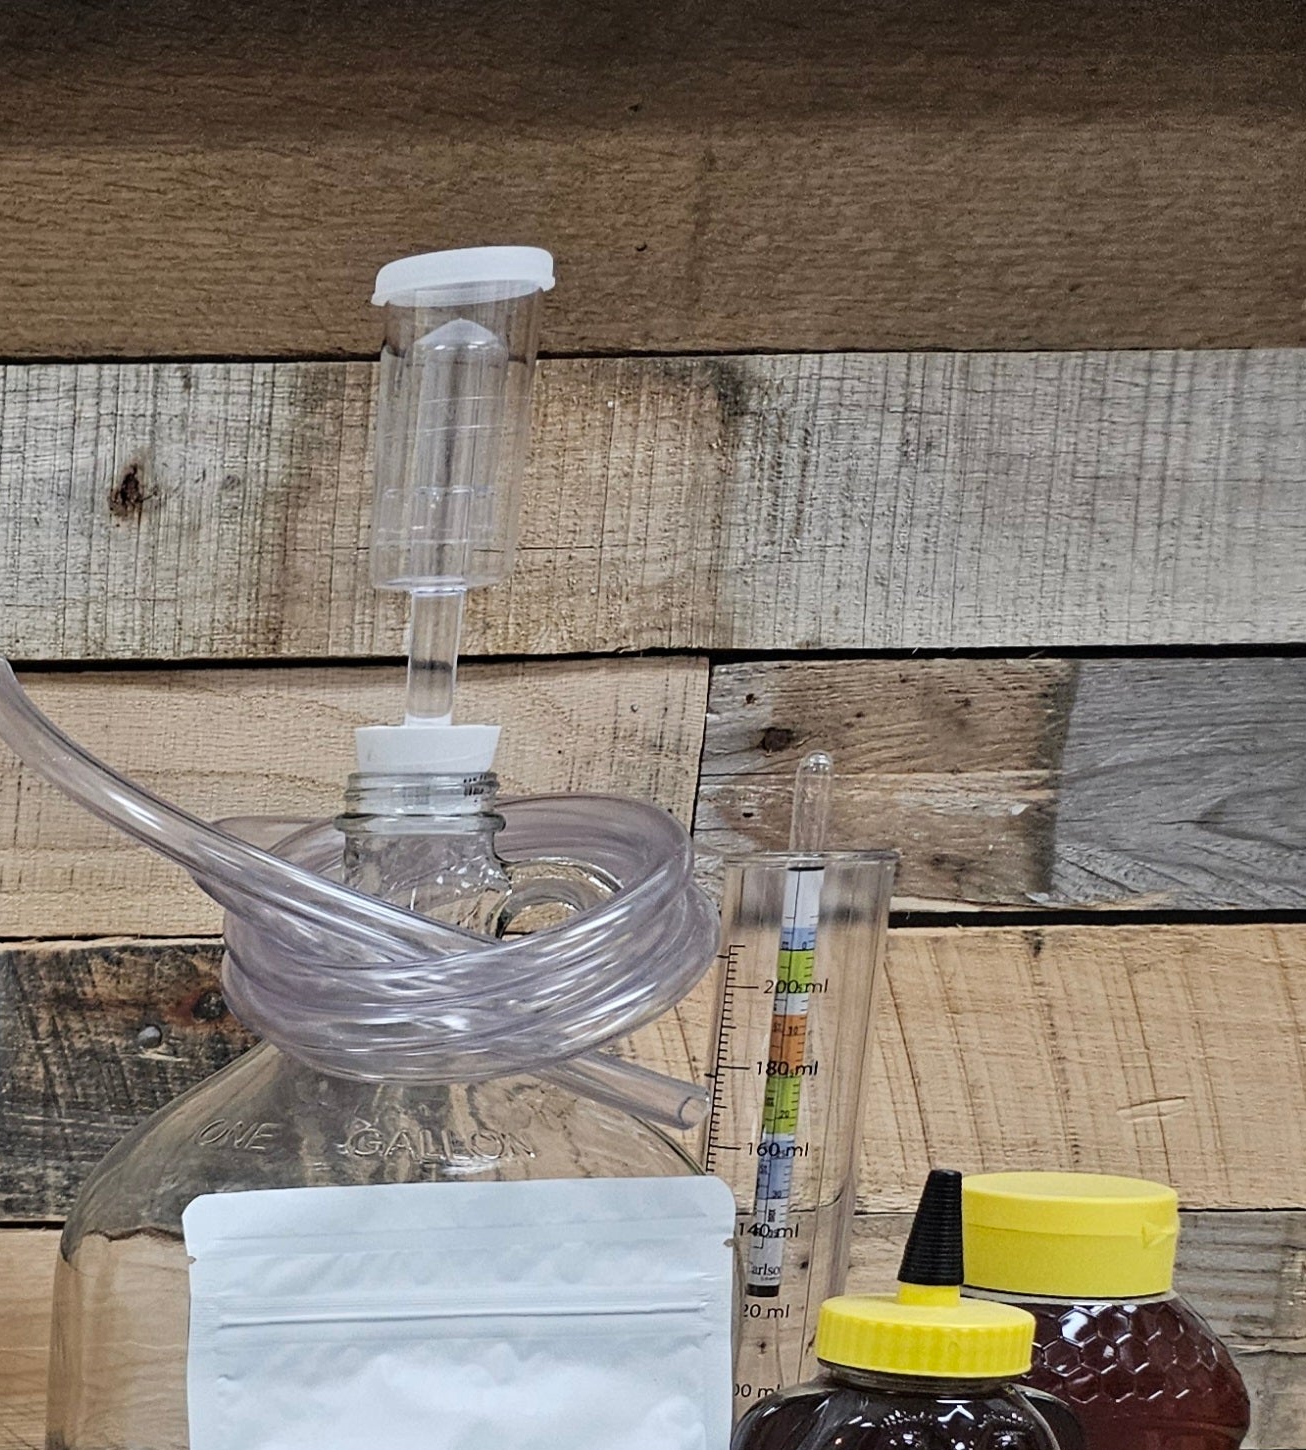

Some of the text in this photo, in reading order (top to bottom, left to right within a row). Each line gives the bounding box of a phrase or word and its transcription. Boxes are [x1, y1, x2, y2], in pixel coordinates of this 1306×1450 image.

[763, 978, 829, 994] 200 ml
[756, 1061, 819, 1077] 180 ml
[193, 1118, 536, 1164] ONE GALLON
[747, 1142, 809, 1157] 160 ml
[738, 1222, 799, 1238] 140 ml
[767, 1303, 790, 1318] ml
